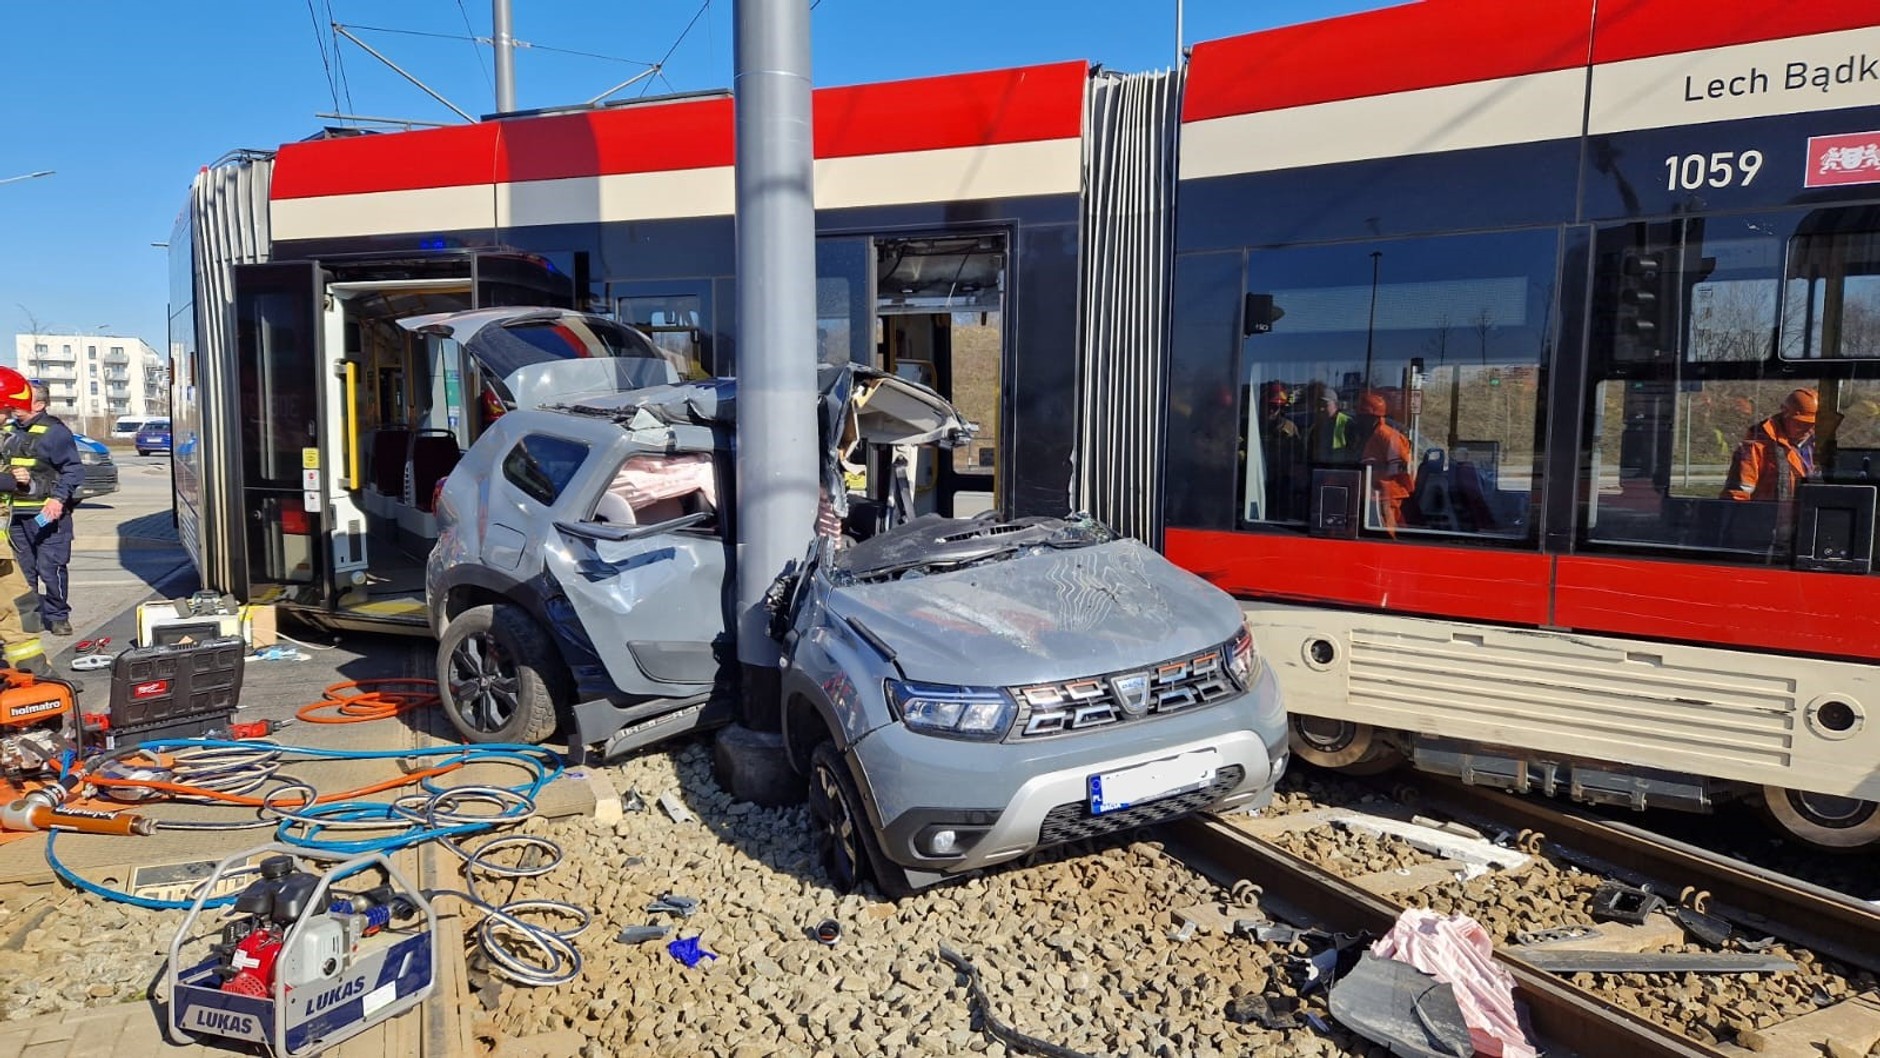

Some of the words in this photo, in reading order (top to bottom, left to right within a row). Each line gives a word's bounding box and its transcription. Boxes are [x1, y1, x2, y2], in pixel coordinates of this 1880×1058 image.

[1685, 67, 1769, 102] Lech
[1665, 149, 1763, 191] 1059
[11, 700, 61, 716] holmatro
[305, 975, 365, 1016] LUKAS
[197, 1009, 252, 1034] LUKAS
